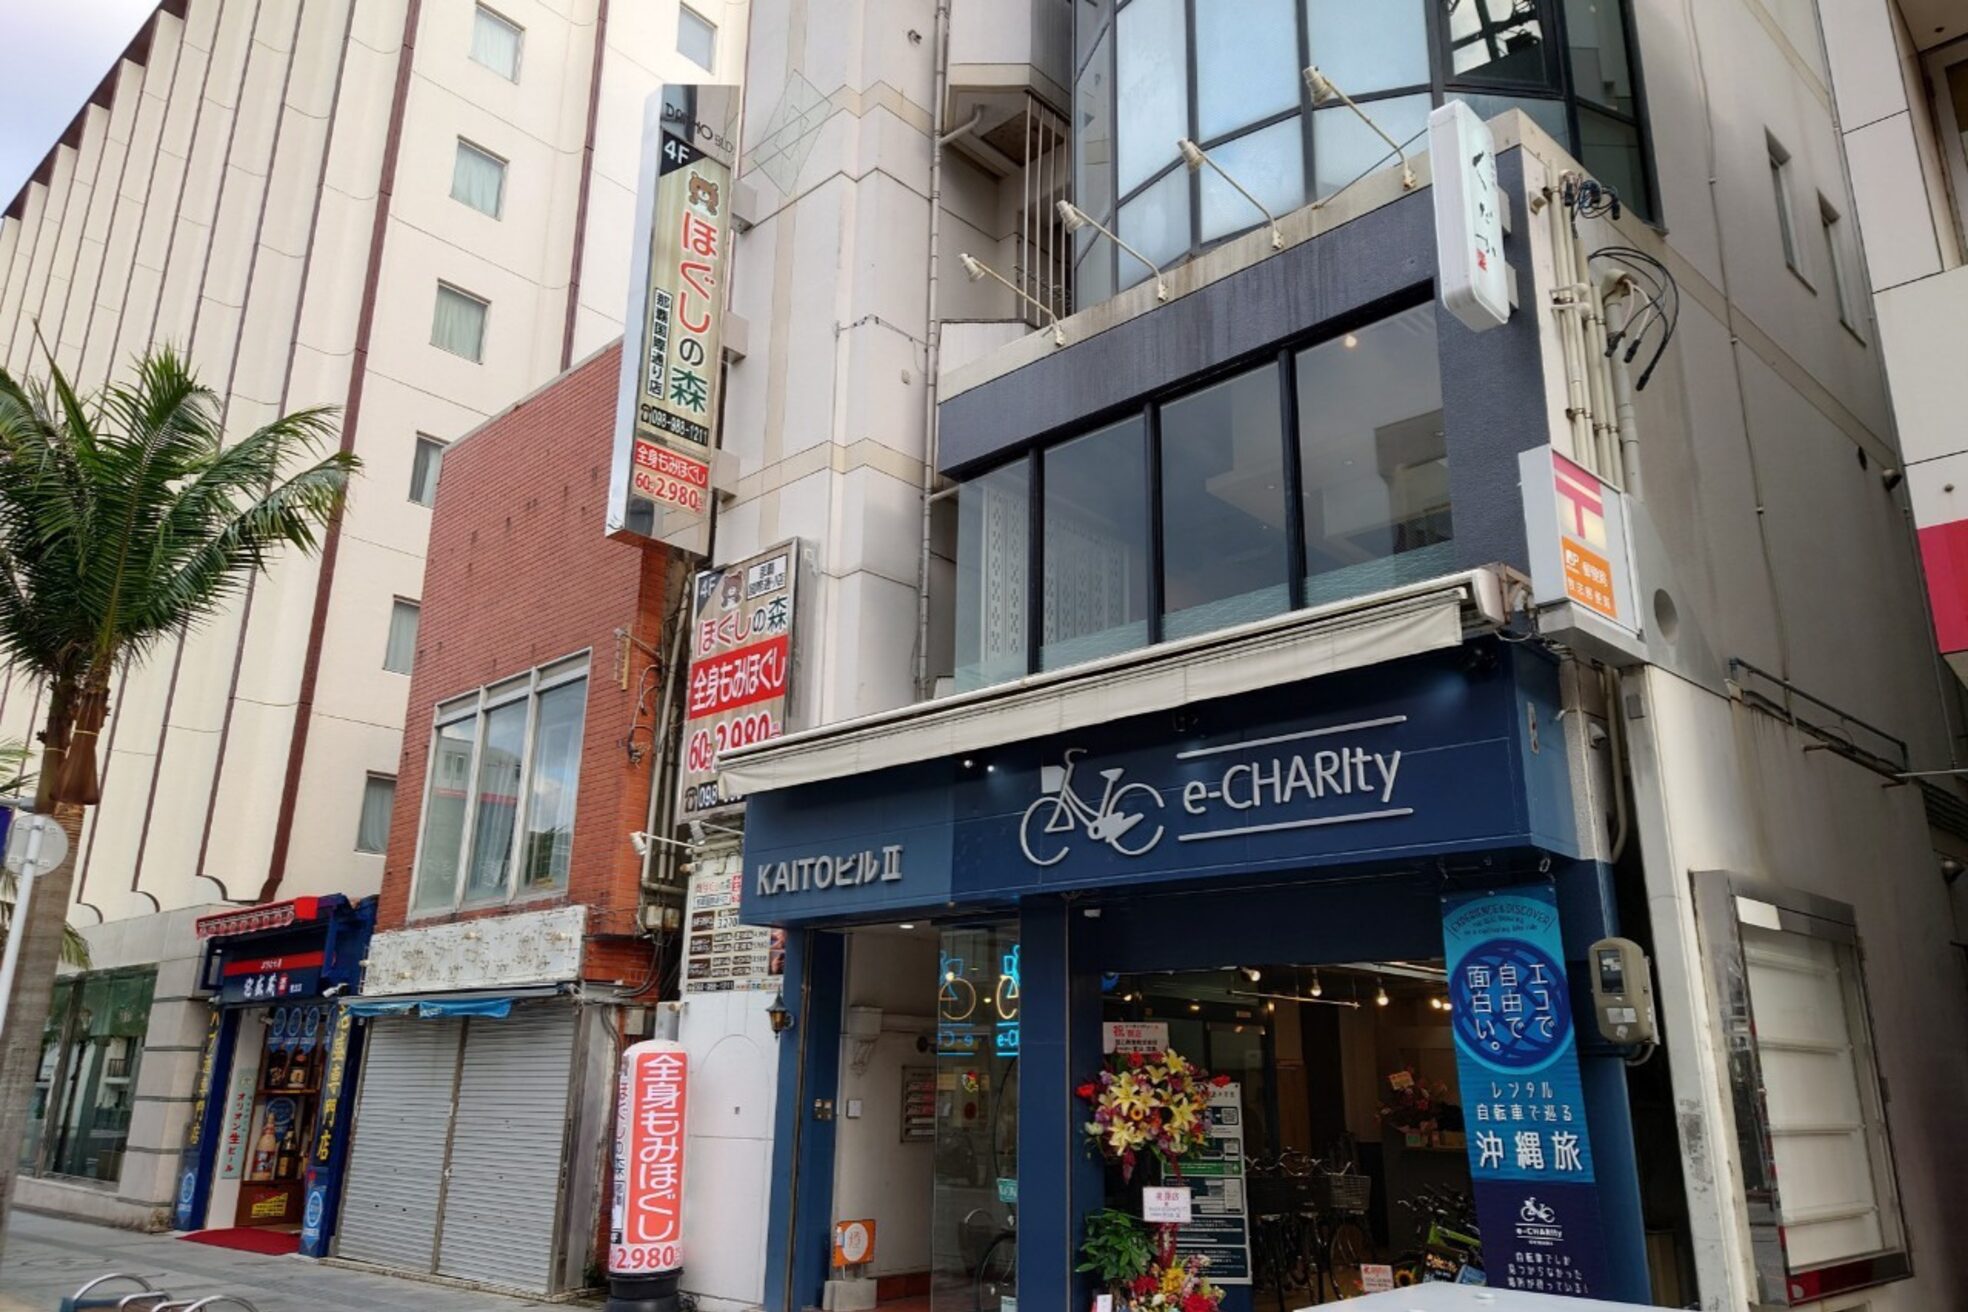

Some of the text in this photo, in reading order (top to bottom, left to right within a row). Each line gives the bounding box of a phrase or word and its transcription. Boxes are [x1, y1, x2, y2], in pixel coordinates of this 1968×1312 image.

[664, 140, 690, 164] 4F
[670, 212, 718, 412] ほぐしの森
[636, 444, 706, 485] 全身もみほぐし
[700, 576, 716, 600] 4F
[698, 595, 788, 657] ほぐしの森
[691, 647, 786, 711] 全身もみほぐし
[1466, 965, 1501, 1051] 面白い。
[1499, 962, 1525, 1039] 自由で
[1529, 963, 1555, 1039] エコで
[1476, 1103, 1573, 1122] 自転車で巡る
[1491, 1081, 1554, 1099] レンタル
[638, 1054, 684, 1242] 全身もみほぐし
[1476, 1130, 1583, 1171] 沖縄旅
